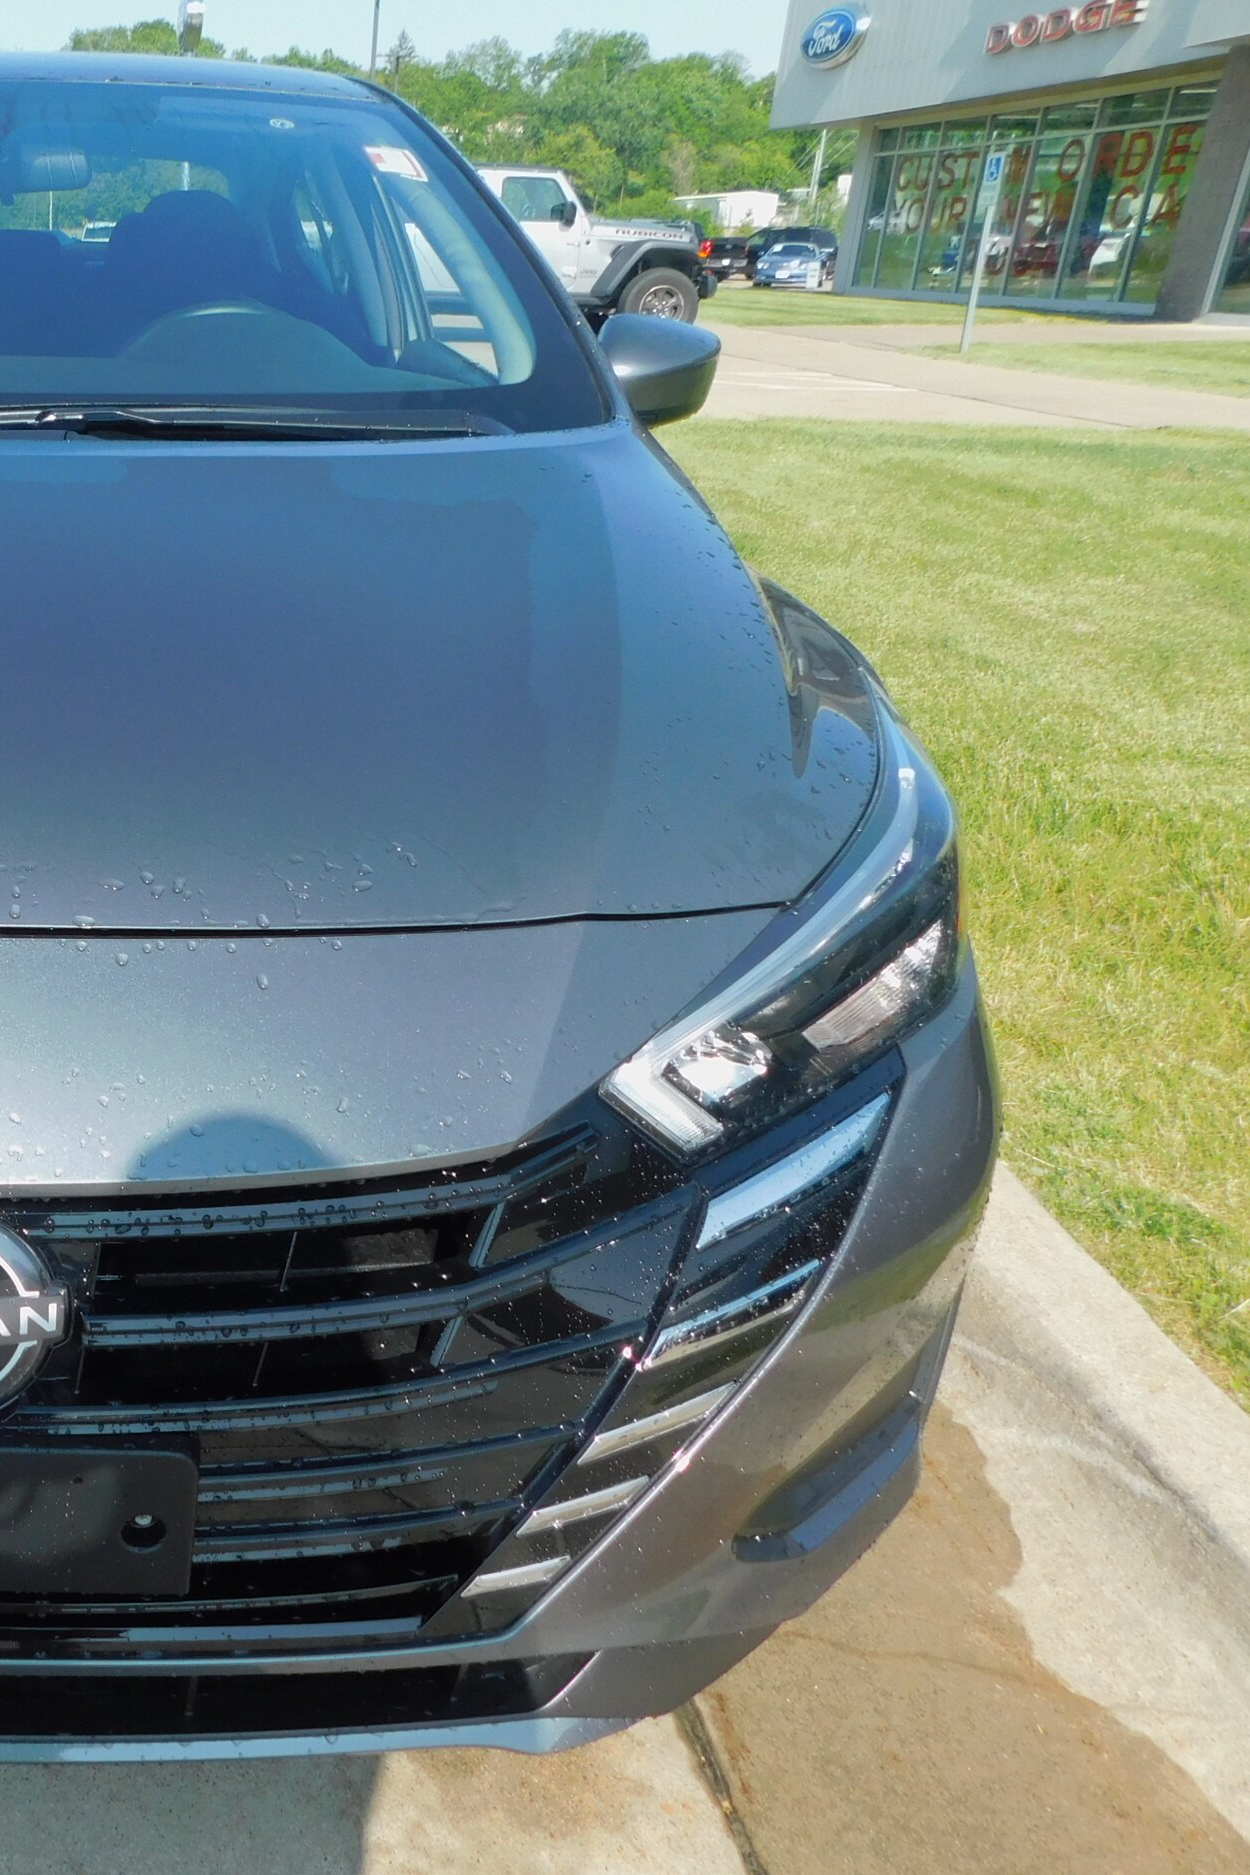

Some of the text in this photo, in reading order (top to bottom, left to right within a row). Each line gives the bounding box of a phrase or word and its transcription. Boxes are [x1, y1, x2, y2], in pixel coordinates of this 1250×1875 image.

[808, 19, 845, 57] Ford
[984, 0, 1149, 55] DODGE
[897, 125, 1198, 192] CUSTM ORDE
[1108, 183, 1180, 231] CA
[615, 228, 684, 240] RUBICON
